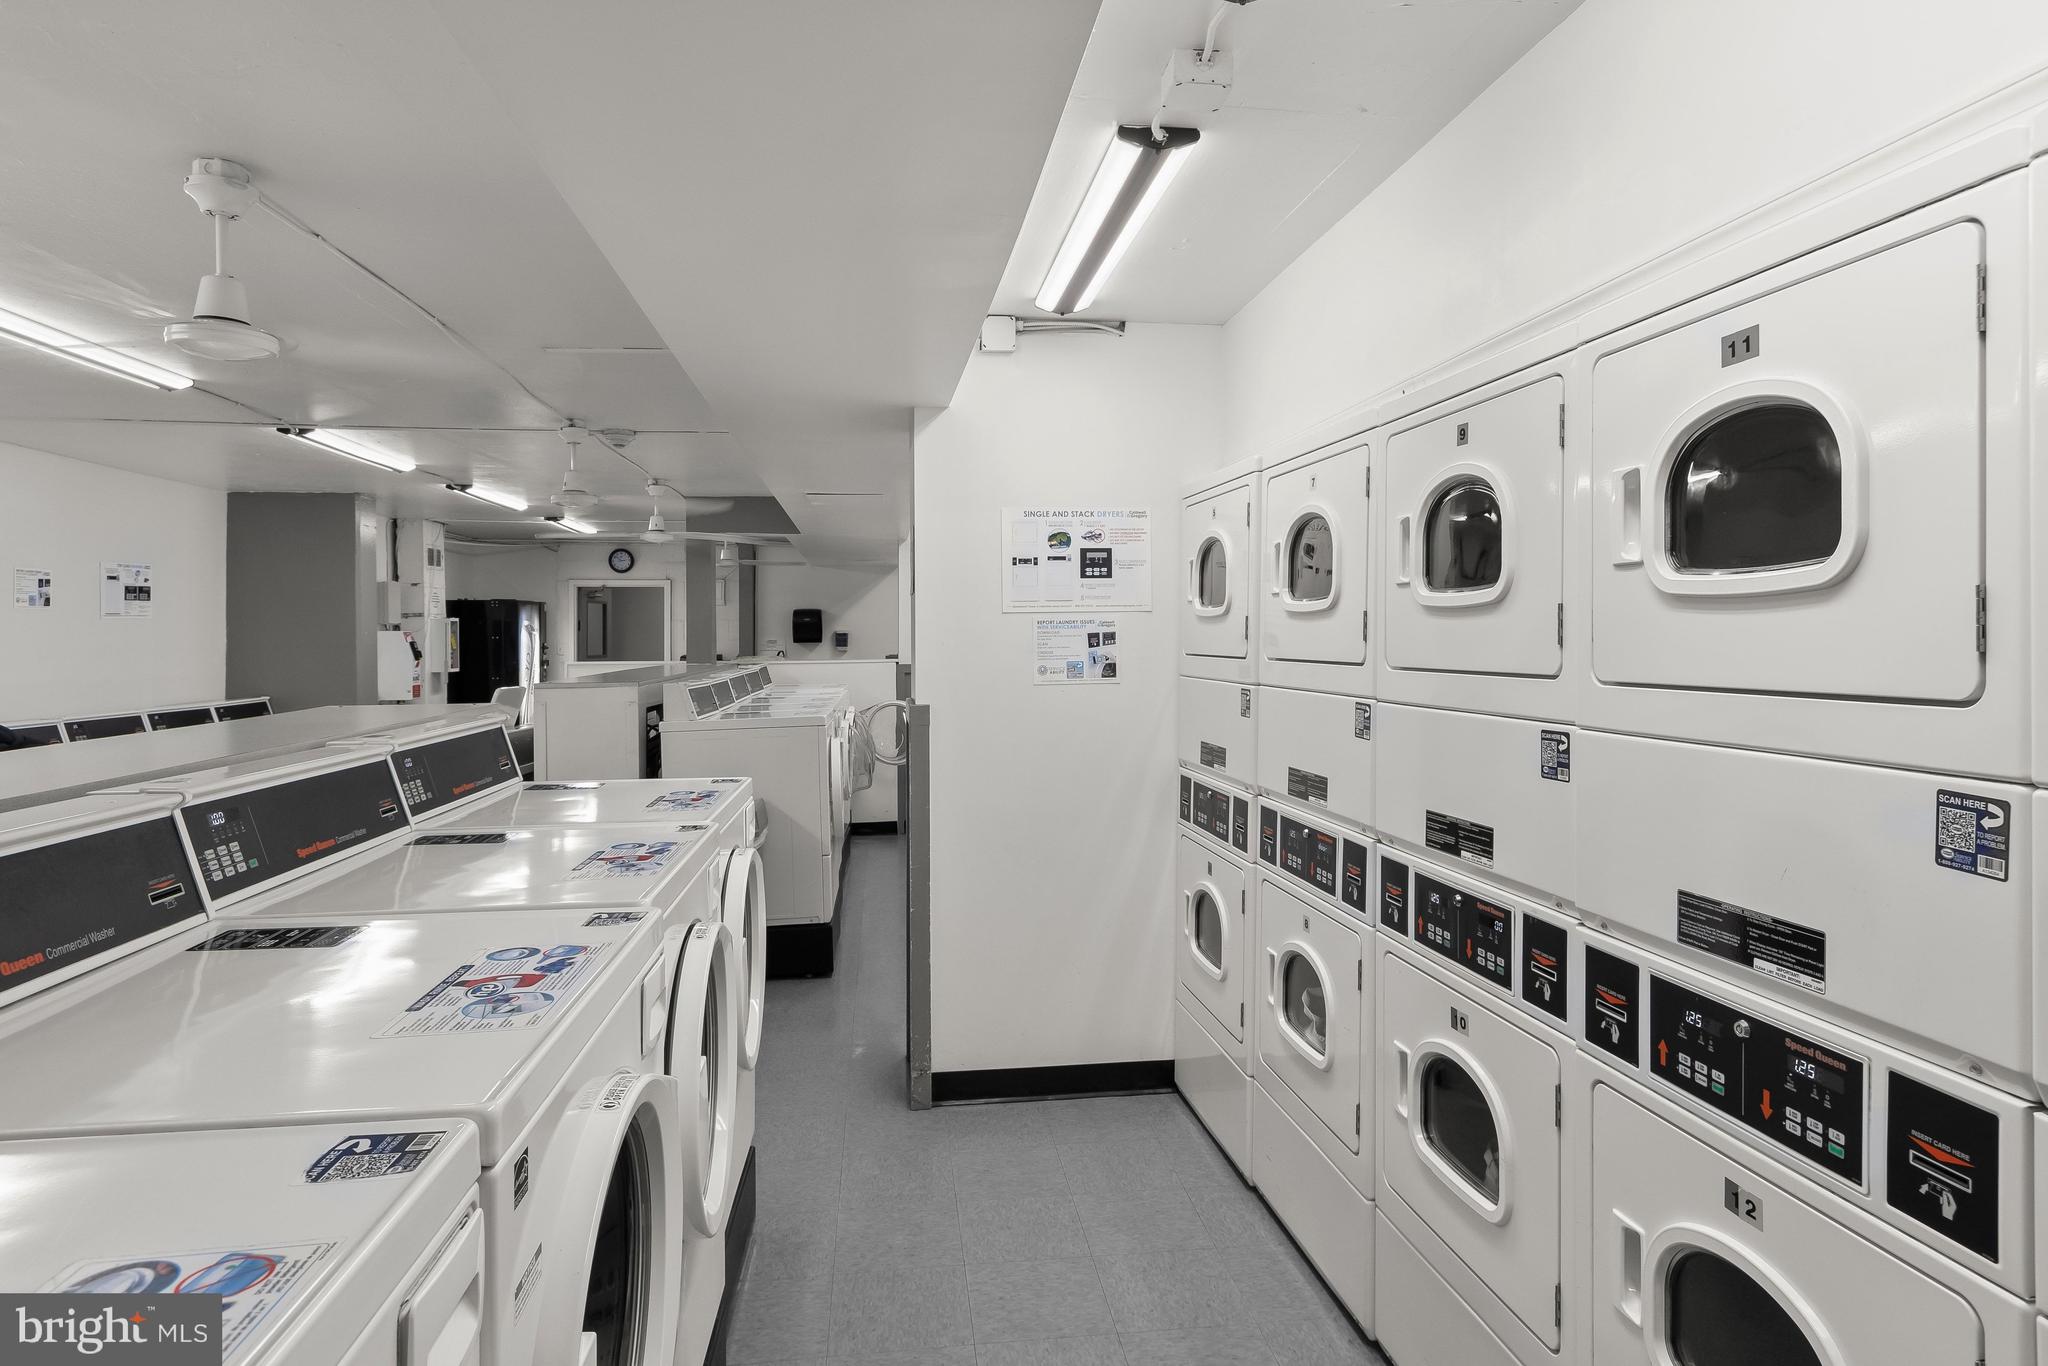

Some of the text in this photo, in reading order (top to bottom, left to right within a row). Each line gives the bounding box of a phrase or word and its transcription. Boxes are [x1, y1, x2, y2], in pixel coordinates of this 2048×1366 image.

[1728, 335, 1750, 358] 11
[1460, 428, 1466, 440] 9
[1024, 510, 1050, 518] SINGLE
[1052, 510, 1068, 518] AND
[1071, 510, 1094, 518] STACK
[1938, 794, 1986, 810] SCAN HERE
[1985, 833, 2005, 842] REPORT
[0, 926, 116, 976] Queen Commercial Washer
[1454, 1014, 1466, 1031] 10
[1784, 1038, 1847, 1070] Speed Queen
[1911, 1129, 1970, 1161] INSERT CARD HERE
[322, 1150, 342, 1167] HERE
[1732, 1191, 1757, 1220] 12
